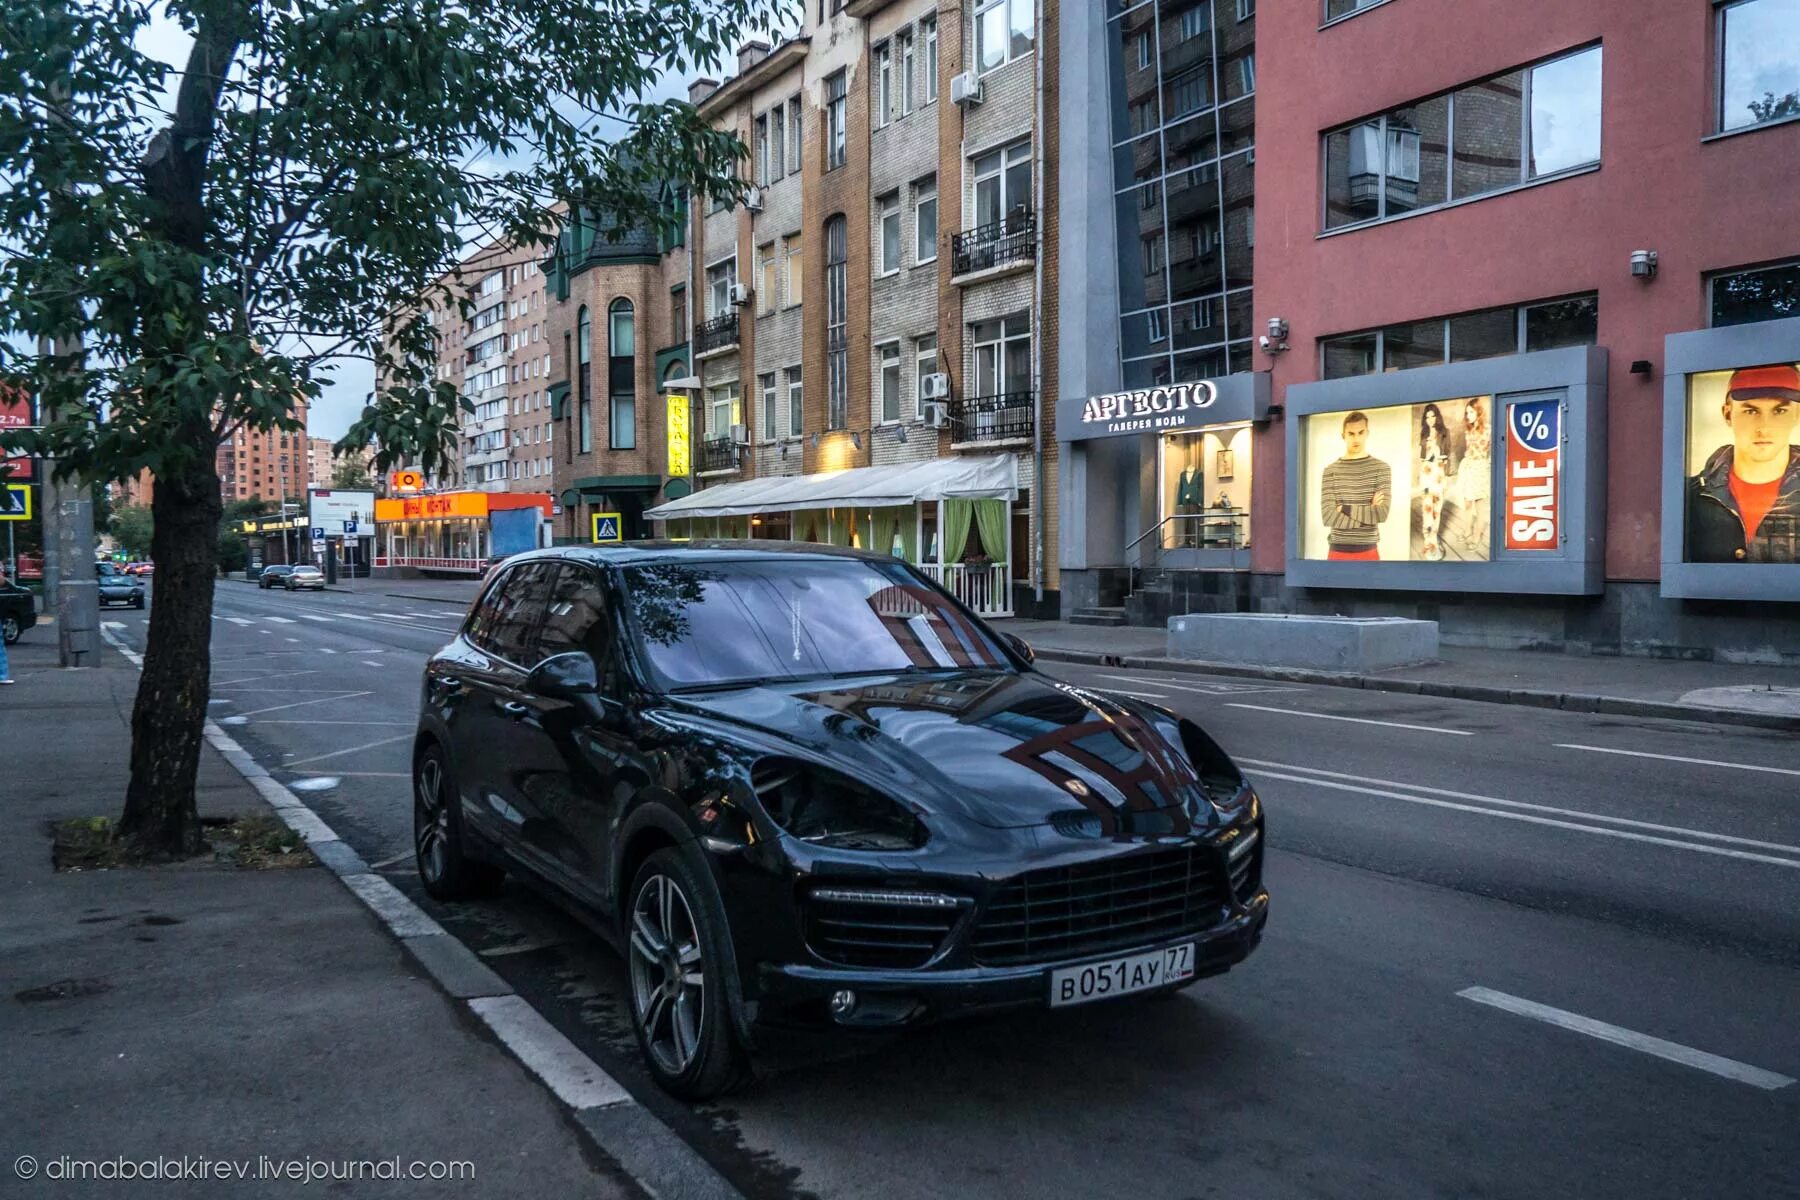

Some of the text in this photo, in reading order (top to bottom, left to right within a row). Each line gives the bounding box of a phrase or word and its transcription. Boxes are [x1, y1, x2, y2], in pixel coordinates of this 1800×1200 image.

[1108, 415, 1185, 433] ГАЛЕРЕЯ МОДЫ
[1511, 458, 1555, 542] SALE
[1168, 946, 1188, 970] 77
